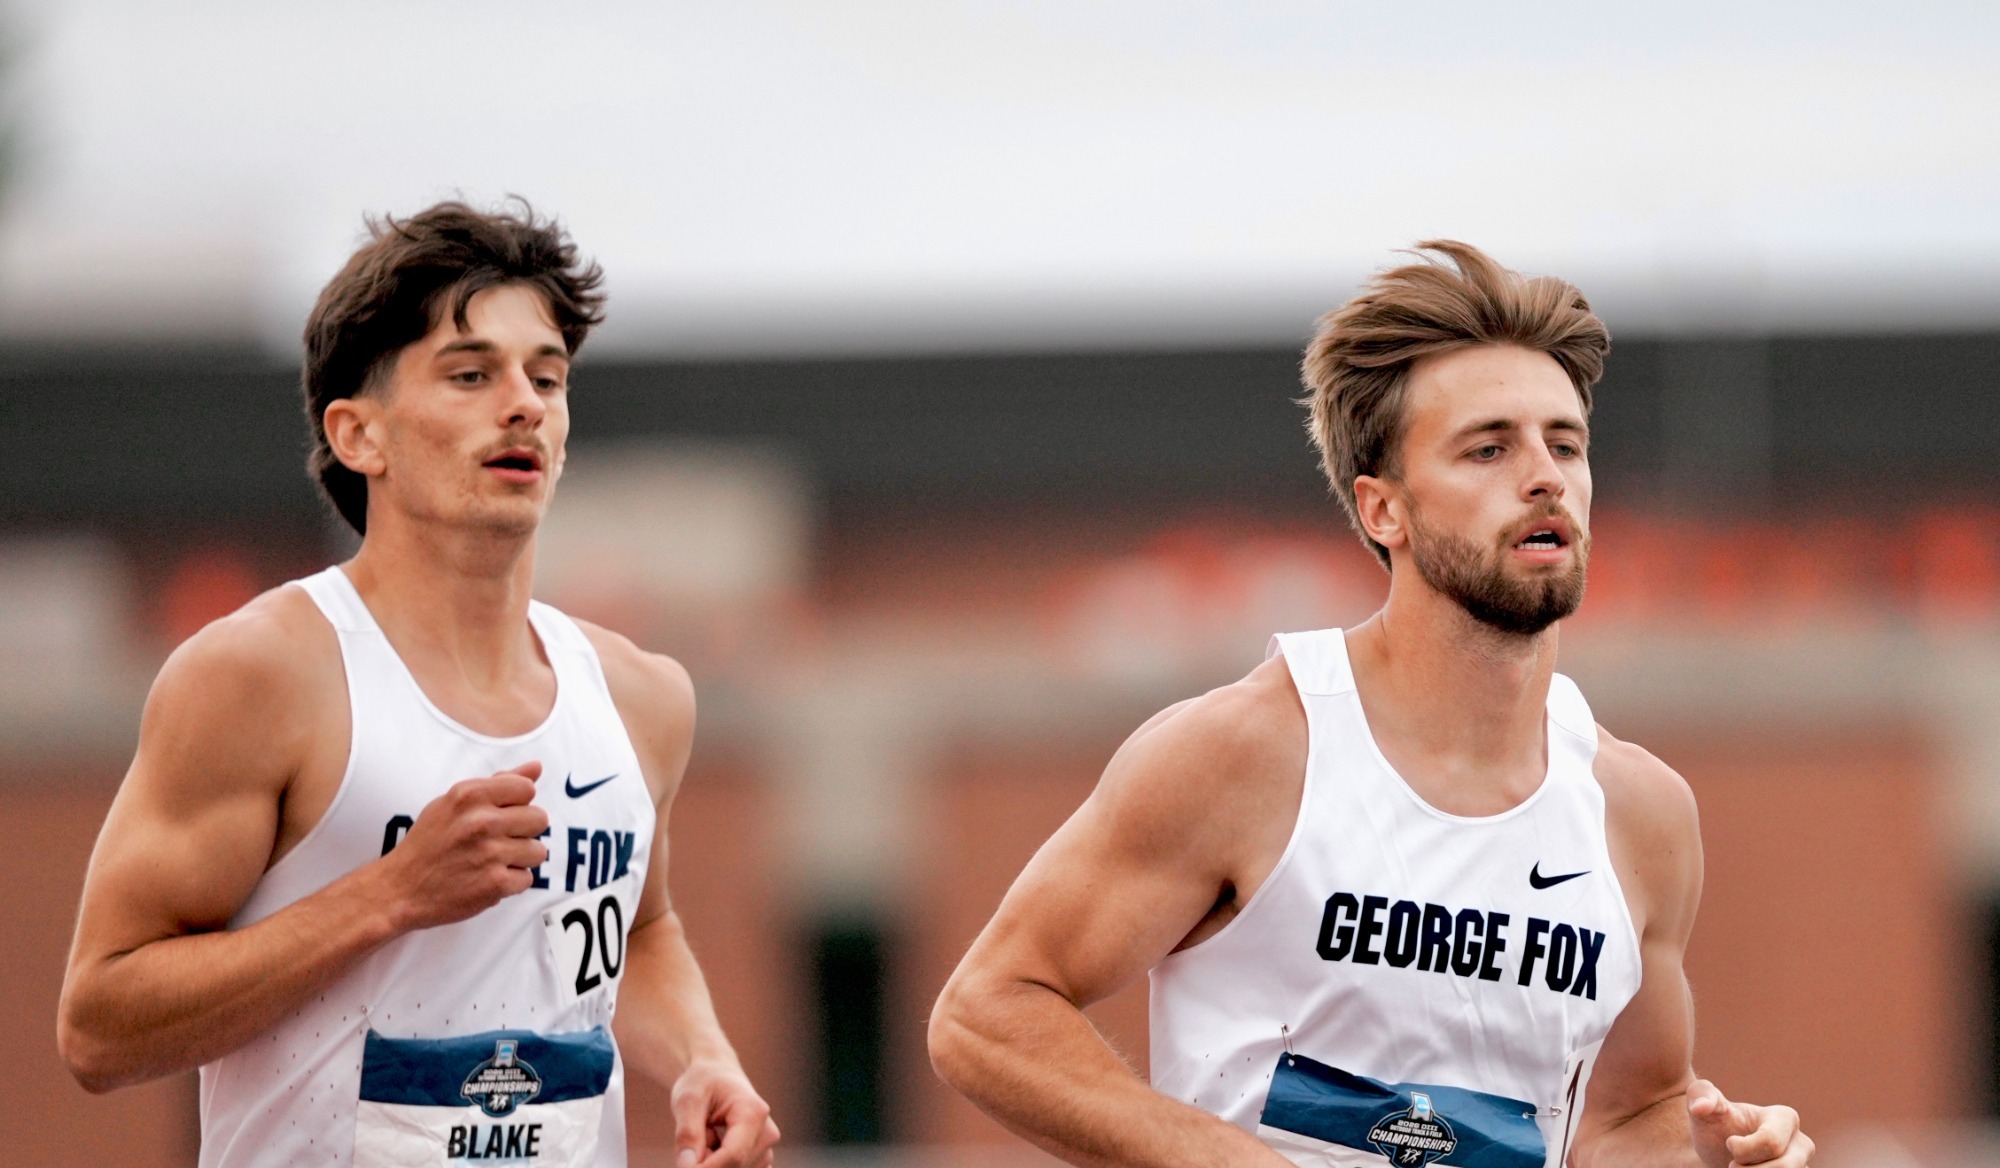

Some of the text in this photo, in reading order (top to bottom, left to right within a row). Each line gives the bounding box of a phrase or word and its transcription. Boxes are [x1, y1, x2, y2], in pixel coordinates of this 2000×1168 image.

[561, 895, 623, 996] 20
[1316, 892, 1606, 1001] GEORGE FOX
[464, 1081, 539, 1095] CHAMPIONSHIPS
[447, 1123, 542, 1159] BLAKE
[1371, 1129, 1453, 1151] CHAMPIONSHIPS
[1412, 1128, 1426, 1136] TRACK
